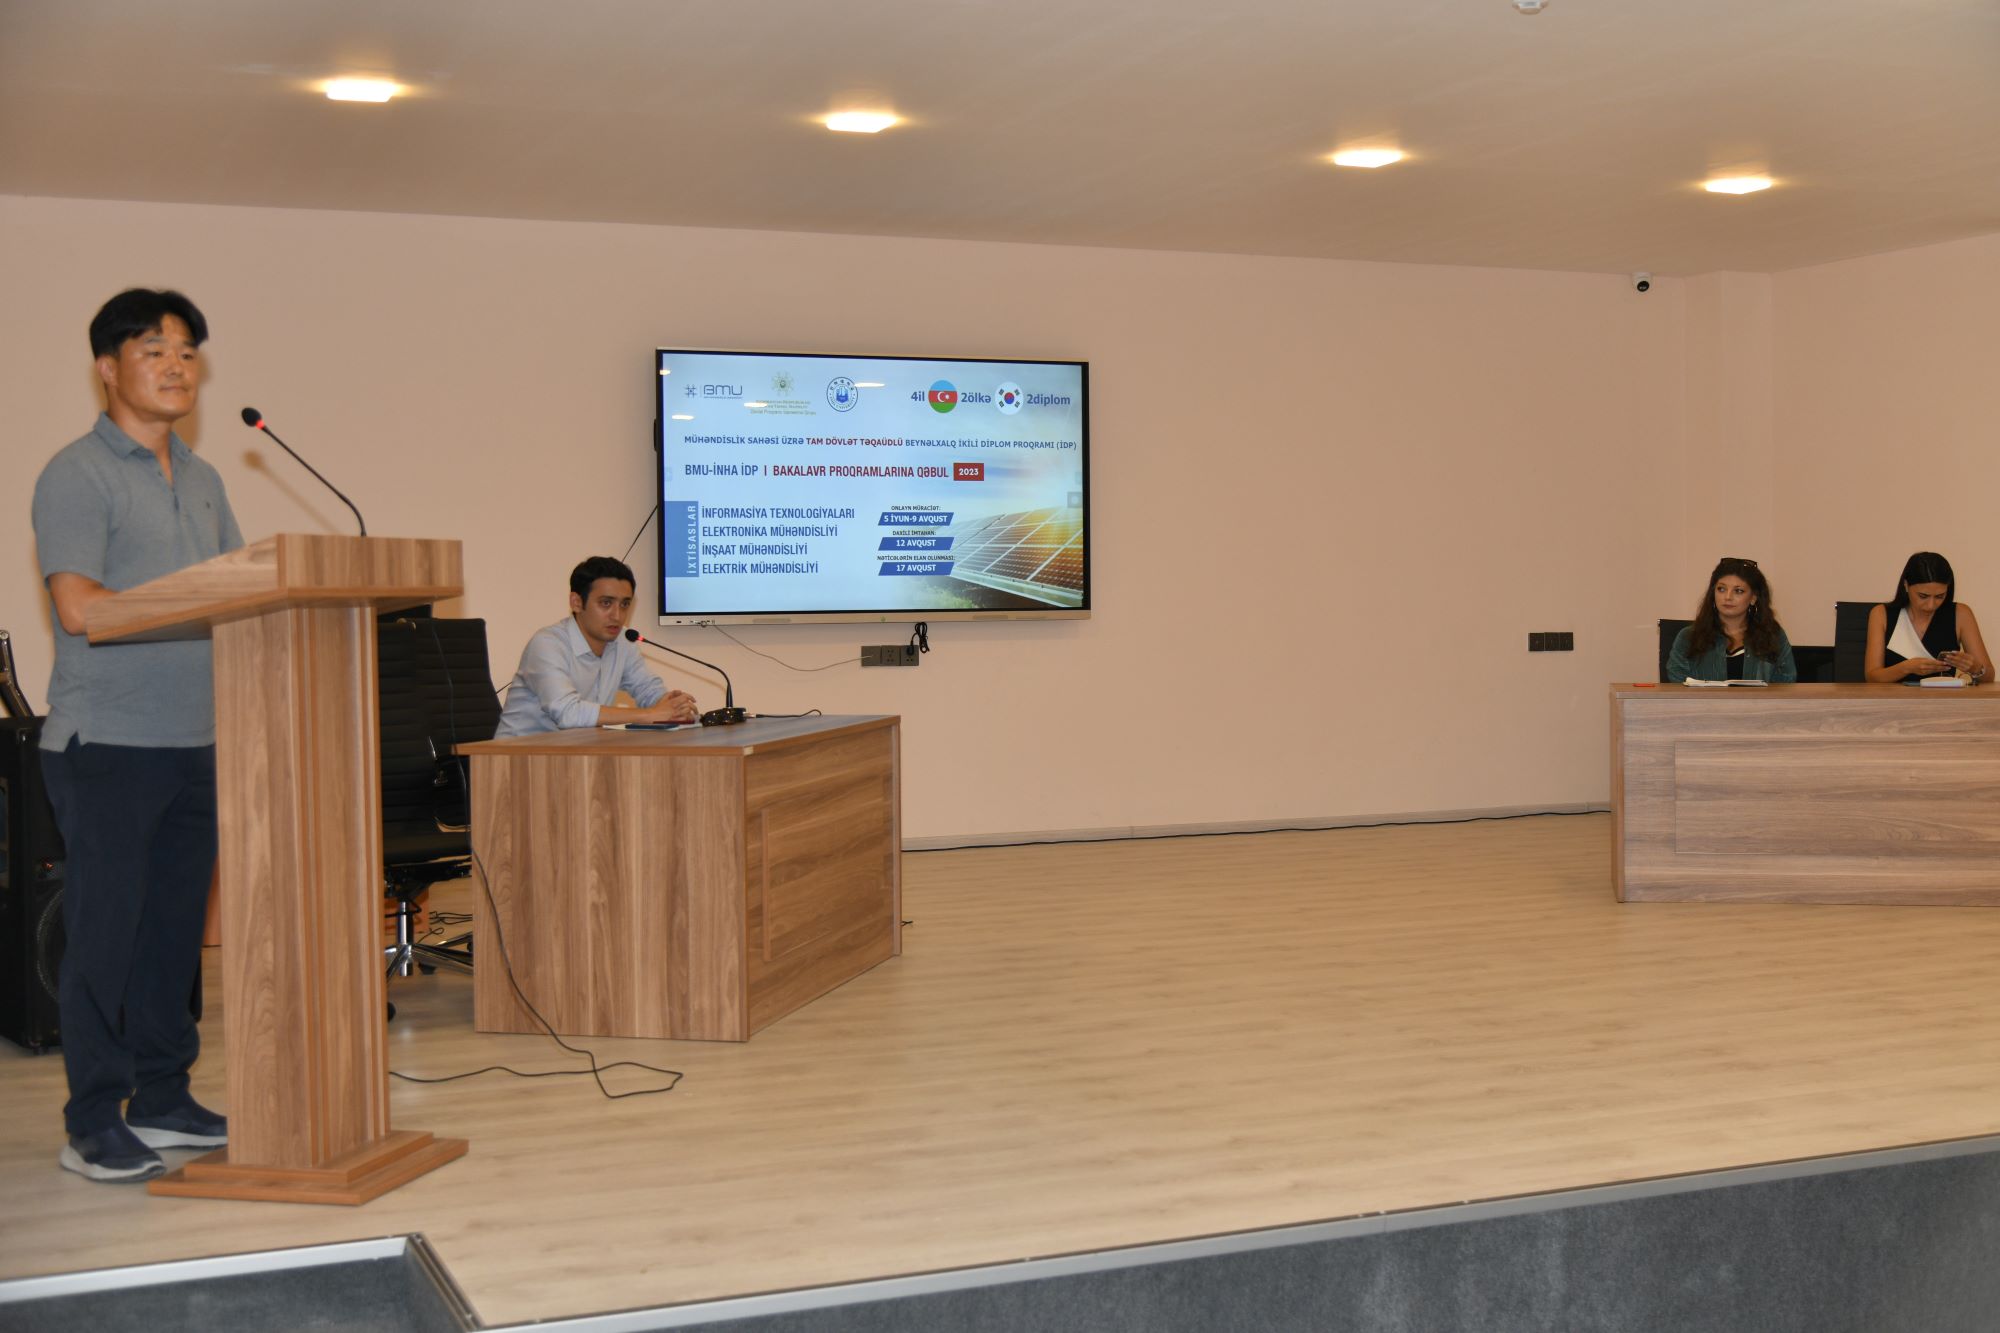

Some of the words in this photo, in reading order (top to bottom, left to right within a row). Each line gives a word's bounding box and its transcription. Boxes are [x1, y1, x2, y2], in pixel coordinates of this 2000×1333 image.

[703, 384, 743, 396] BMU
[911, 391, 925, 401] 4il
[961, 392, 991, 403] 2ölkə
[1026, 394, 1071, 407] 2diplom
[684, 434, 745, 444] MÜHƏNDİSLİK
[748, 435, 779, 445] SAHƏSİ
[782, 435, 804, 445] ÜZRƏ
[806, 438, 824, 446] TAM
[826, 436, 858, 446] DÖVLƏT
[860, 437, 903, 447] TƏQAÜDLÜ
[905, 439, 956, 448] BEYNƏLXALQ
[959, 438, 978, 447] İKİLİ
[981, 438, 1011, 448] DİPLOM
[1013, 441, 1054, 450] PROQRAMI
[1056, 440, 1077, 450] (İDP)
[685, 461, 738, 476] BMU-İNHA
[741, 462, 759, 476] İDP
[773, 465, 826, 476] BAKALAVR
[830, 465, 914, 478] PROQRAMLARINA
[917, 466, 949, 478] QƏBUL
[958, 468, 979, 476] 2023
[702, 505, 768, 519] İNFORMASİYA
[770, 505, 855, 519] TEXNOLOGİYALARI
[891, 513, 917, 522] İYUN-9
[918, 515, 948, 523] AVQUST
[702, 524, 768, 537] ELEKTRONİKA
[770, 524, 838, 537] MÜHƏNDİSLİYİ
[687, 505, 697, 574] İXTİSASLAR
[896, 539, 905, 547] 12
[907, 539, 936, 548] AVQUST
[702, 542, 736, 558] İNŞAAT
[740, 542, 808, 555] MÜHƏNDİSLİYİ
[702, 561, 748, 574] ELEKTRİK
[750, 561, 818, 574] MÜHƏNDİSLİYİ
[896, 564, 905, 572] 17
[907, 564, 936, 573] AVQUST
